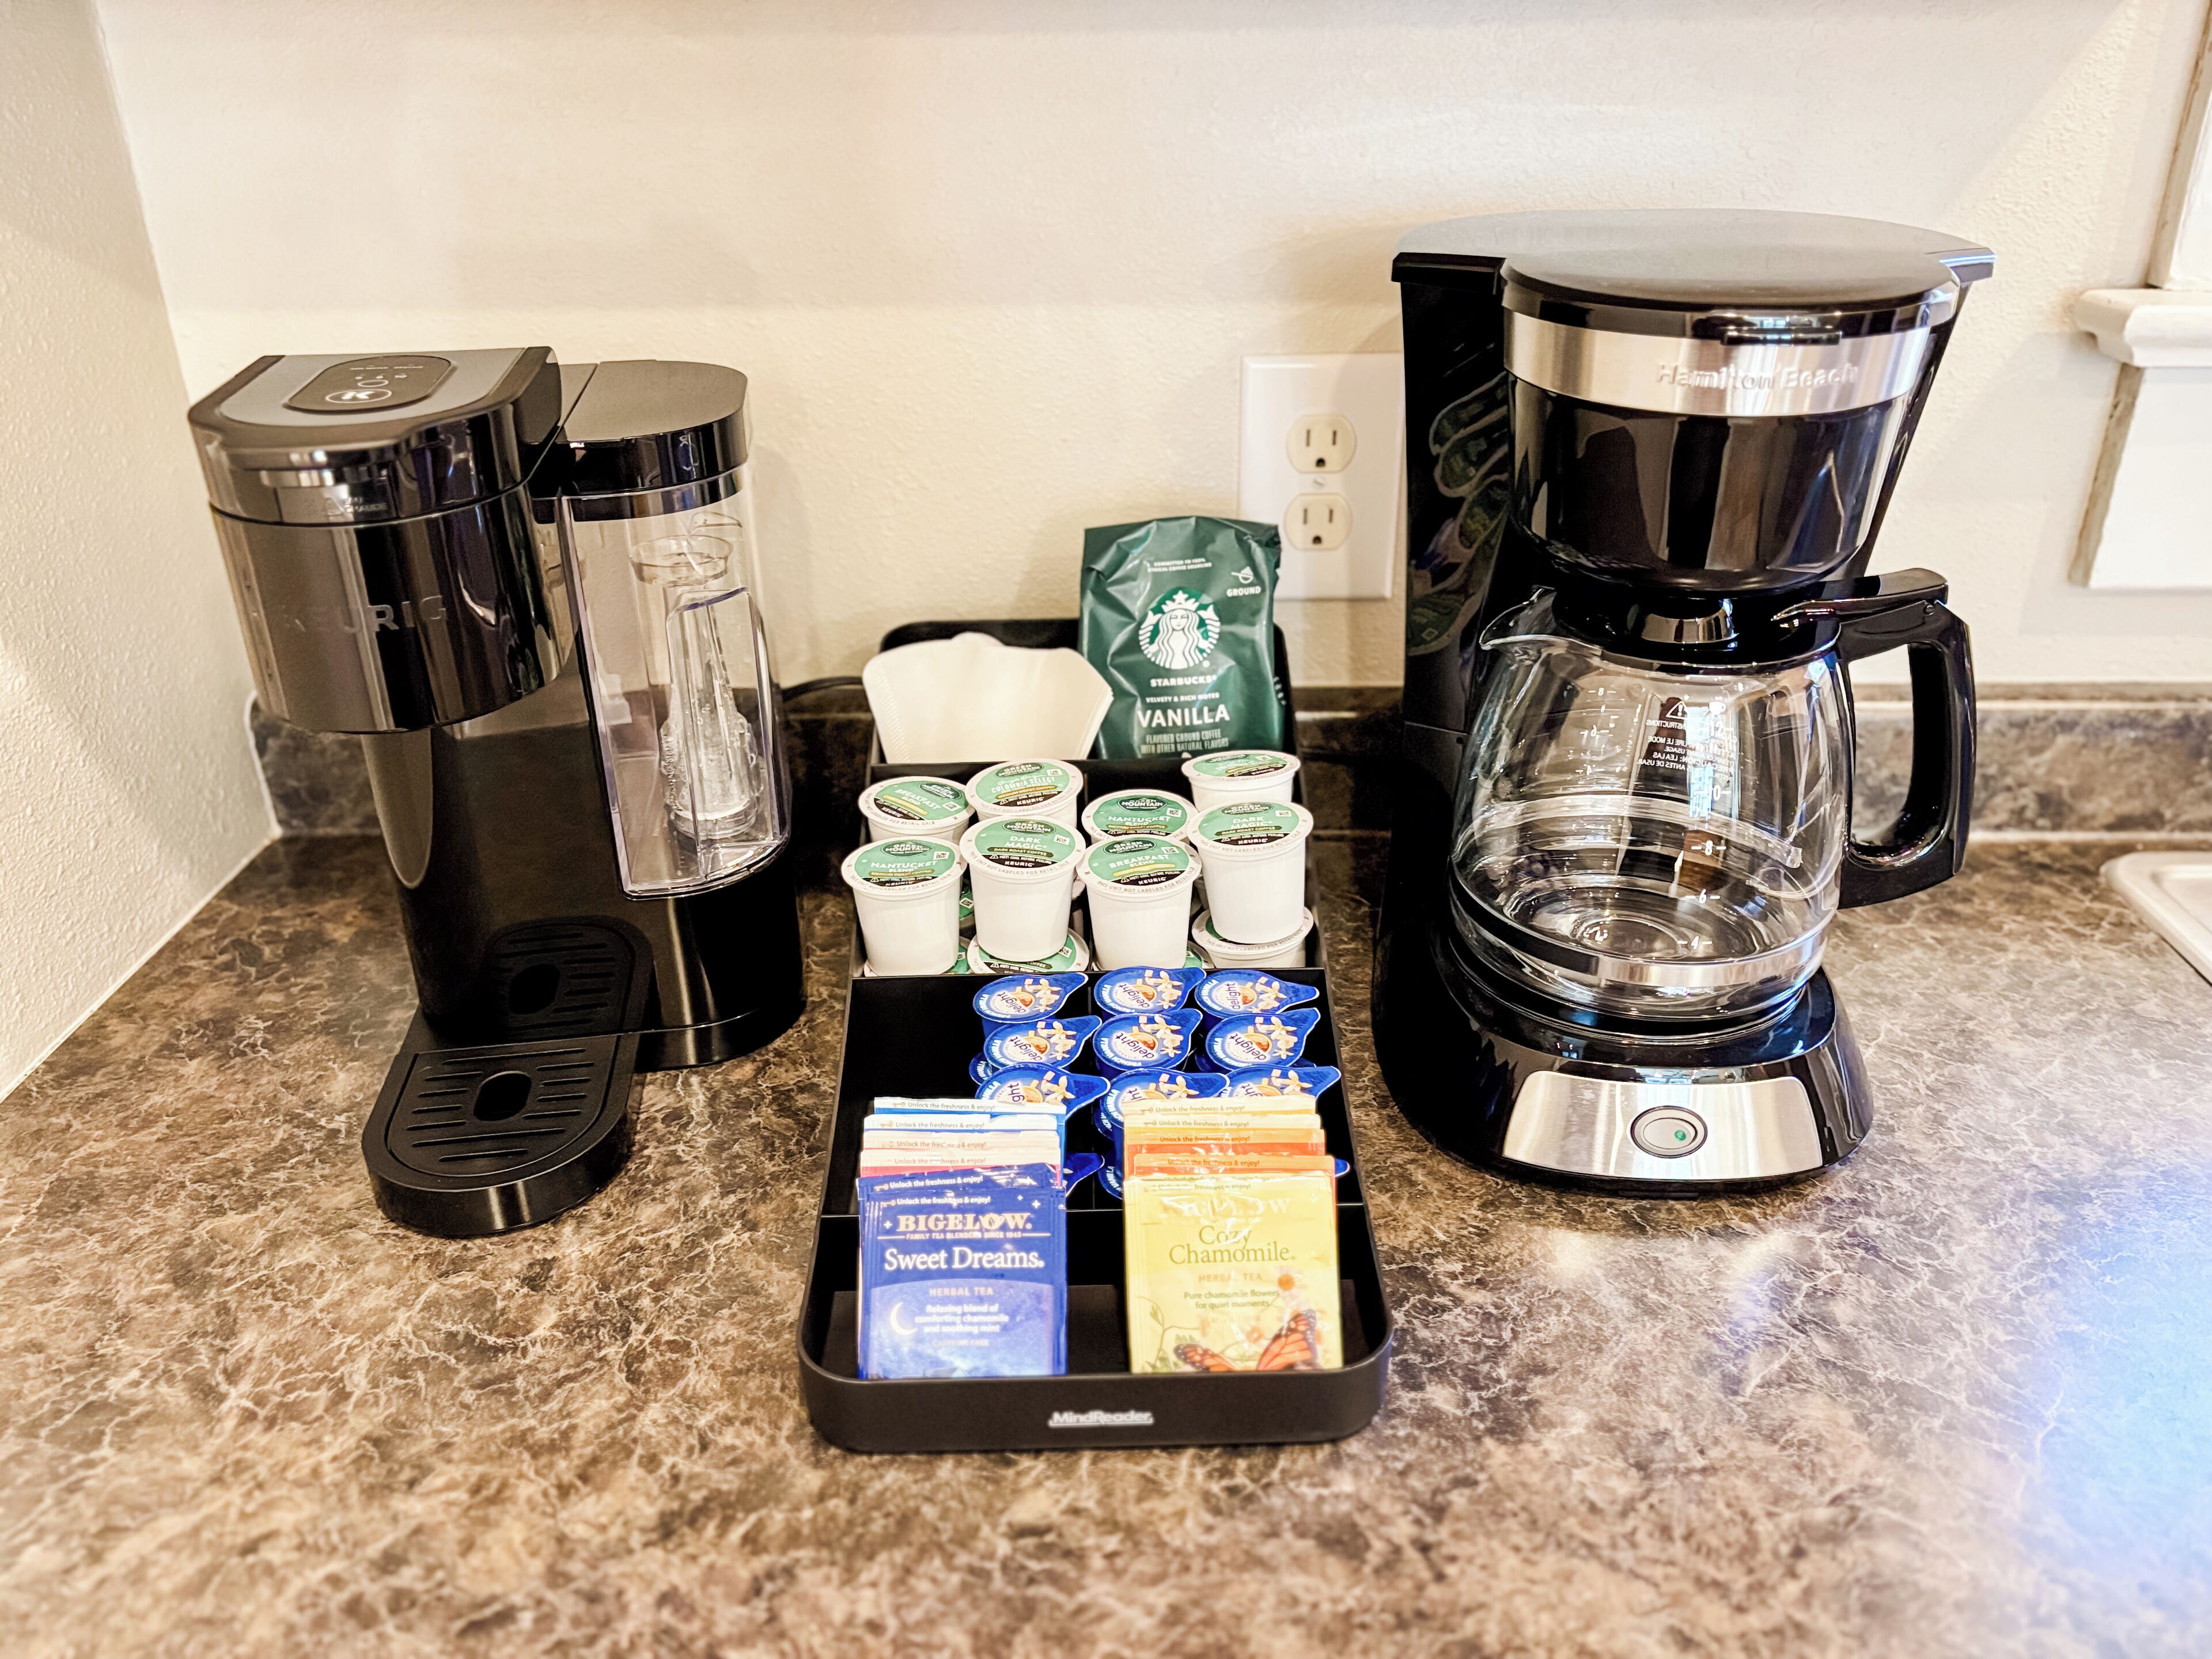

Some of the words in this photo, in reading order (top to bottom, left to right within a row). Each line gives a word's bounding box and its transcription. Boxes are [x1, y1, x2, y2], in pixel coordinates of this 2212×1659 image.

[1658, 362, 1775, 391] Hamilton
[1779, 362, 1859, 388] Beach
[1226, 586, 1261, 597] GROUND
[1137, 704, 1230, 728] VANILLA
[1146, 734, 1175, 744] FLAVORED
[1176, 732, 1200, 742] GROUND
[1202, 729, 1221, 740] COFFEE
[1141, 744, 1155, 753] WITH
[1157, 743, 1175, 753] OTHER
[1177, 741, 1203, 751] NATURAL
[1205, 737, 1229, 749] FLAVORS
[991, 779, 1029, 793] COLOMBIA
[1031, 777, 1055, 785] SELECT
[895, 789, 941, 810] BREAKFAST
[901, 796, 921, 805] BLEND
[1231, 822, 1267, 830] MAGIC
[1010, 836, 1041, 844] DARK
[1108, 843, 1153, 853] MOUNTAIN
[1109, 854, 1169, 868] BREAKFAST
[1699, 889, 1706, 904] 6
[1691, 935, 1699, 949] 4
[997, 991, 1027, 1014] delight
[1119, 983, 1150, 1008] delight
[1226, 982, 1241, 1010] delight
[1009, 1036, 1043, 1061] delight
[1115, 1032, 1154, 1059] delight
[1230, 1033, 1267, 1061] delight
[925, 1177, 956, 1185] freshness
[963, 1175, 983, 1183] enjoy!
[1199, 1225, 1252, 1249] Cozy
[884, 1248, 948, 1270] Sweet
[1198, 1274, 1238, 1282] HERBA
[1243, 1272, 1263, 1281] TEA
[929, 1288, 970, 1296] HERBAL
[974, 1287, 993, 1295] TEA
[1204, 1290, 1248, 1299] chamomile
[926, 1304, 963, 1314] Relaxing
[963, 1304, 988, 1312] blend
[989, 1304, 999, 1312] of
[1209, 1301, 1229, 1310] quiet
[915, 1315, 961, 1324] comforting
[963, 1313, 1009, 1322] chamomile
[923, 1324, 940, 1332] and
[941, 1324, 979, 1334] soothing
[980, 1324, 1000, 1332] mint
[1052, 1409, 1152, 1424] MindReader
